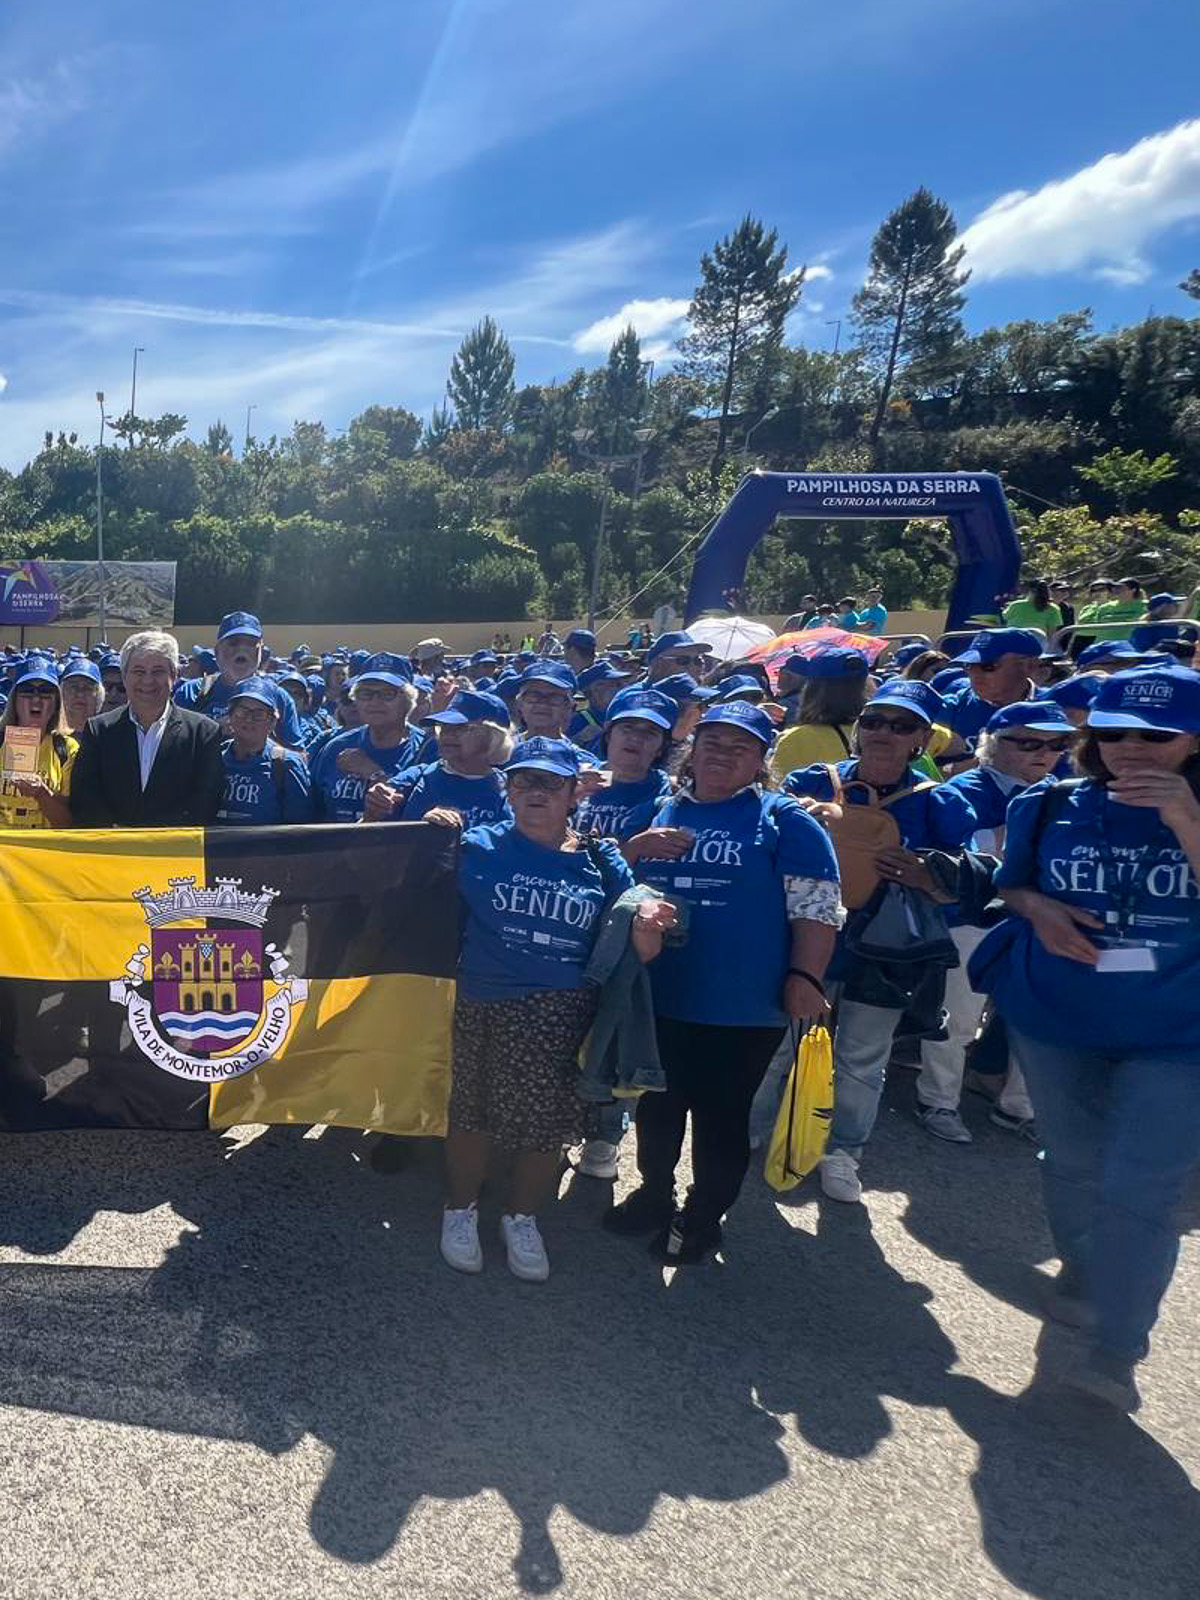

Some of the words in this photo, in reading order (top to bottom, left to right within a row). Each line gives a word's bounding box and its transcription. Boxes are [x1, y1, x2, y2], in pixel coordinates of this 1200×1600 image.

[787, 479, 894, 493] PAMPILHOSA
[896, 480, 920, 493] DA
[923, 480, 981, 493] SERRA
[822, 497, 864, 506] CENTRO
[864, 497, 881, 506] DA
[881, 497, 936, 506] NATUREZA
[133, 1007, 151, 1042] VILA
[148, 1038, 166, 1057] DE
